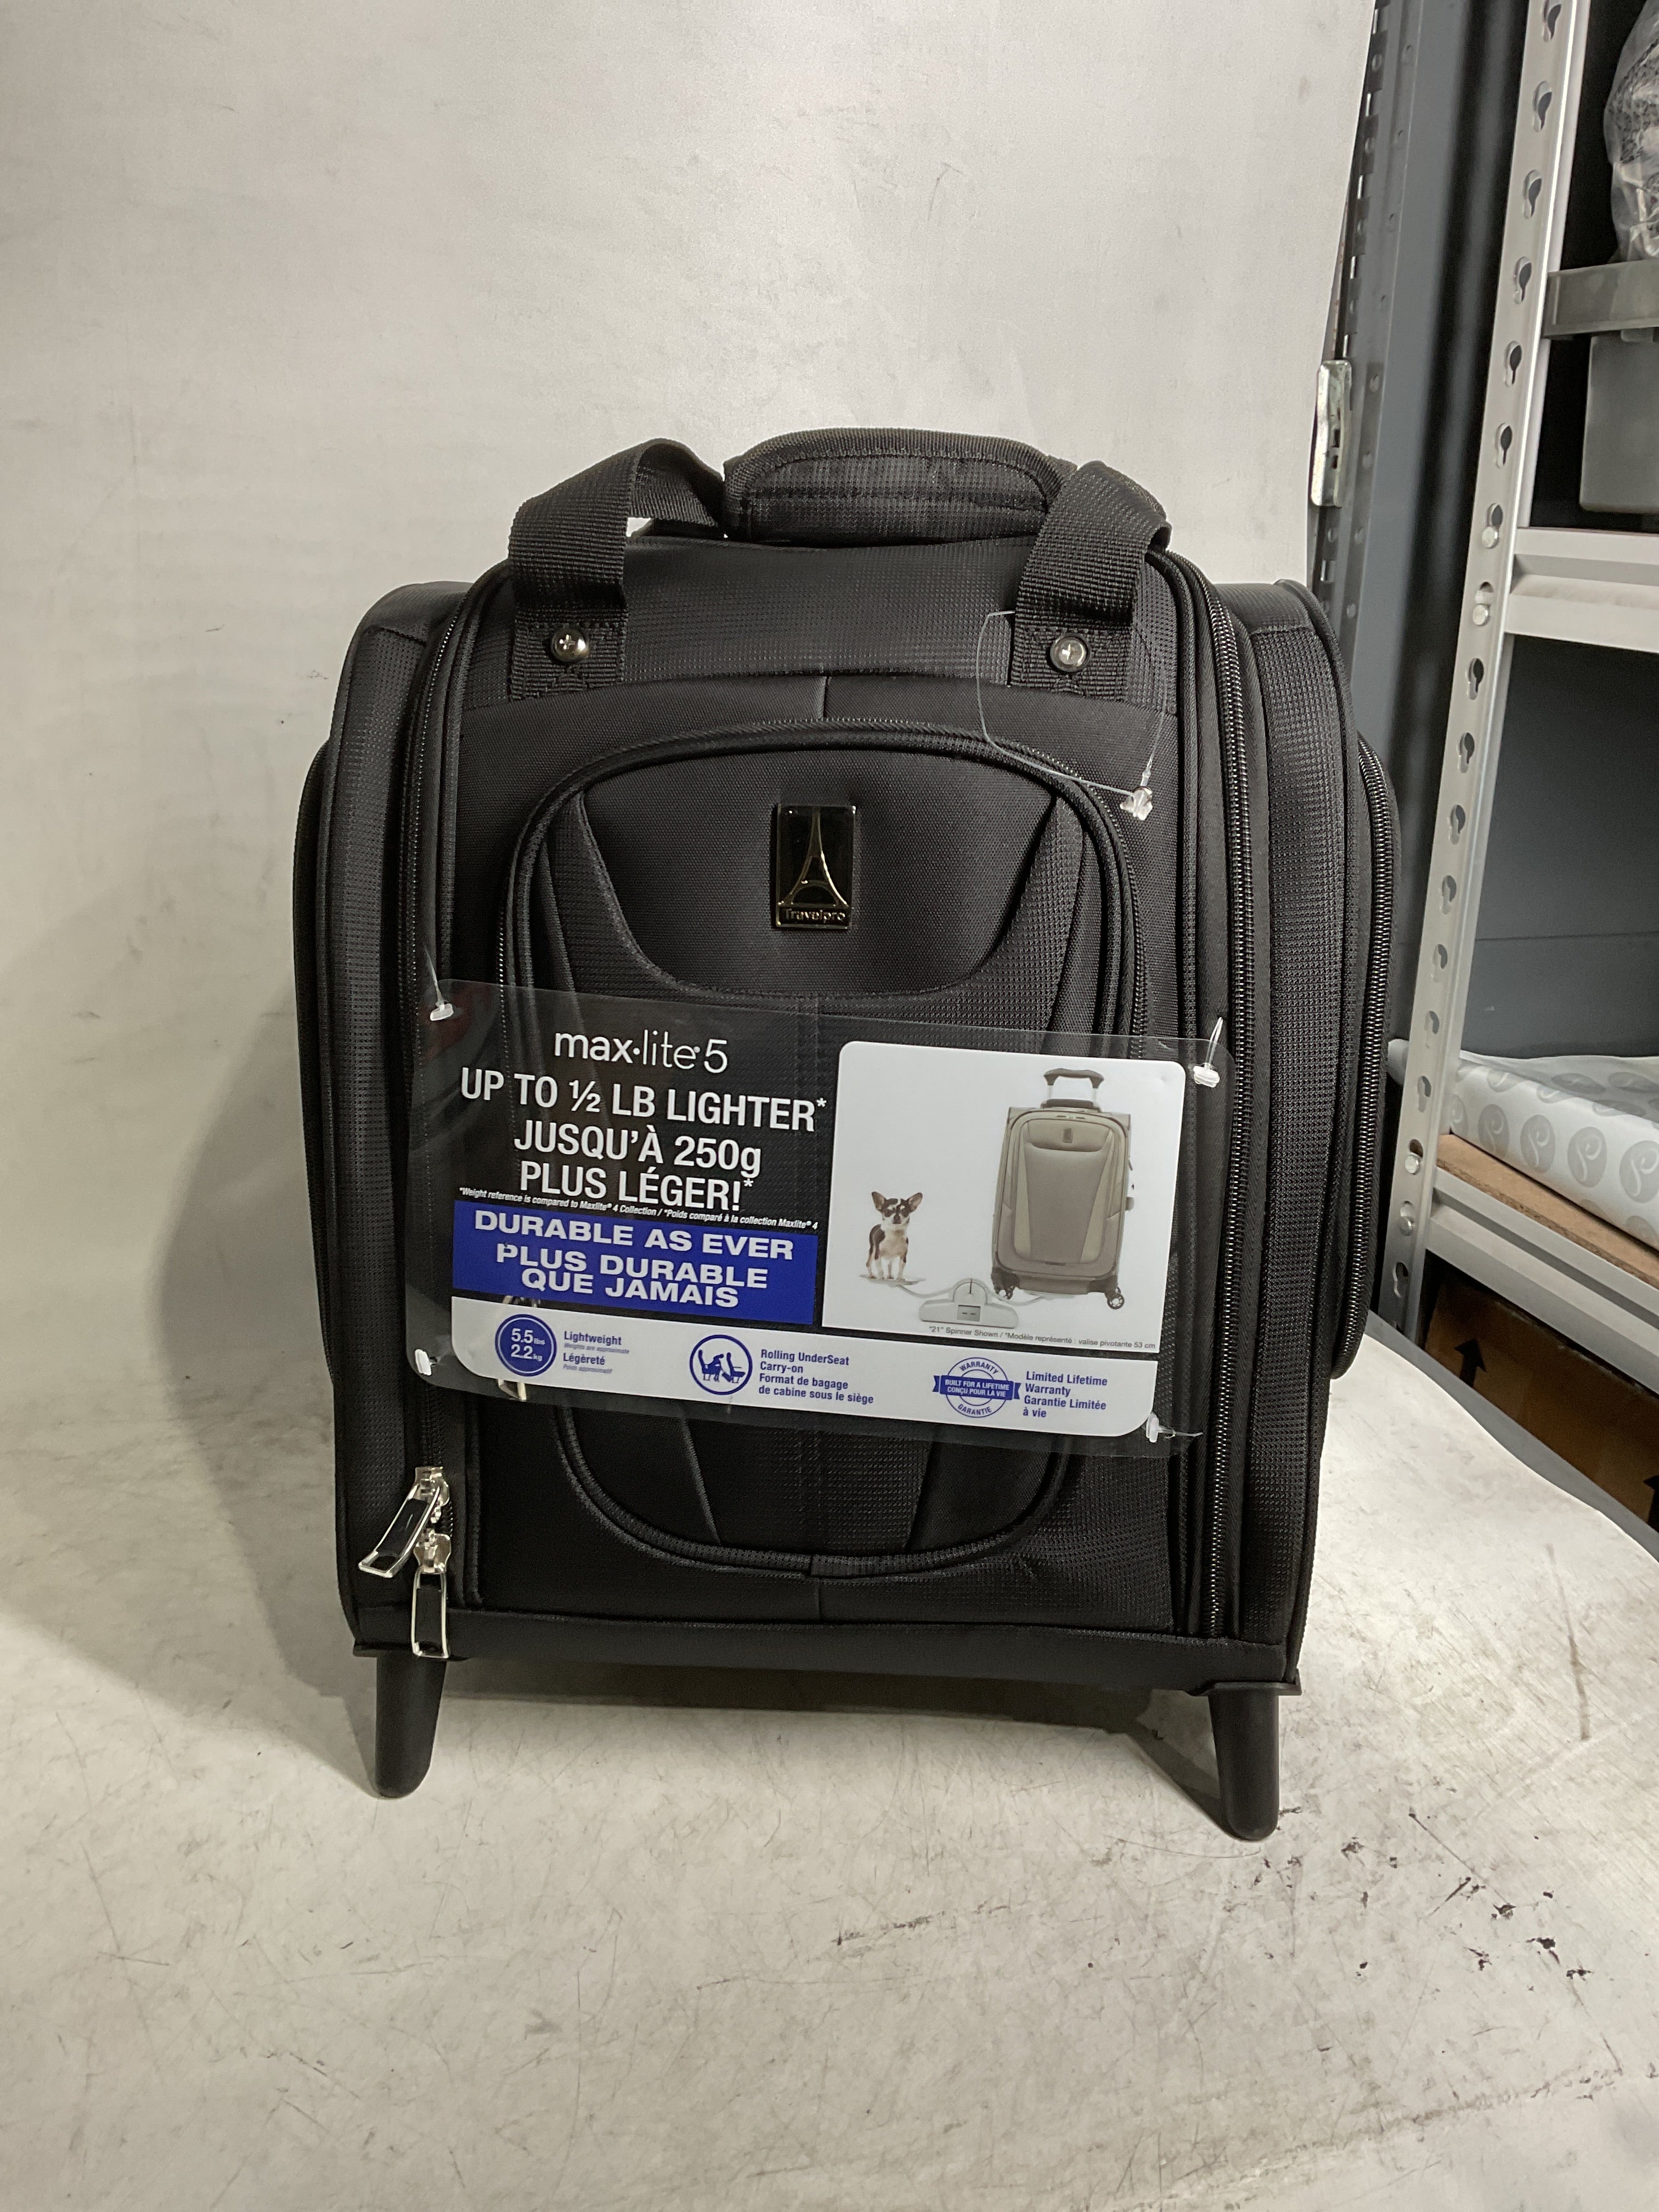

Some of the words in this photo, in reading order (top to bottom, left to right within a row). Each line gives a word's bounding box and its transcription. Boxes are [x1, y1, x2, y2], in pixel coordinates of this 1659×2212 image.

[785, 908, 846, 924] Travelpro
[461, 1067, 504, 1101] UP
[514, 1073, 558, 1108] TO
[612, 1084, 656, 1118] LB
[674, 1136, 761, 1178] 250g
[521, 1160, 607, 1199] PLUS
[488, 1191, 523, 1202] reference
[524, 1194, 531, 1203] is
[532, 1197, 569, 1207] compared
[571, 1200, 579, 1208] to
[619, 1206, 657, 1216] Collection
[689, 1212, 723, 1223] comparé
[724, 1214, 730, 1222] à
[730, 1215, 738, 1223] la
[740, 1216, 777, 1227] collection
[475, 1210, 634, 1246] DURABLE
[644, 1229, 692, 1252] AS
[702, 1234, 794, 1261] EVER
[496, 1243, 588, 1272] PLUS
[600, 1255, 769, 1289] DURABLE
[521, 1268, 595, 1294] QUE
[605, 1278, 740, 1308] JAMAIS
[564, 1330, 622, 1346] Lightweight
[946, 1327, 972, 1335] Spinner
[974, 1329, 998, 1338] Shown
[1035, 1335, 1073, 1344] représenté
[1100, 1340, 1132, 1348] pivotante
[563, 1352, 605, 1365] Légèreté
[761, 1349, 795, 1362] Rolling
[798, 1352, 850, 1365] UnderSeat
[760, 1361, 804, 1374] Carry-on
[960, 1361, 999, 1374] WARRANTY
[759, 1373, 794, 1385] Format
[797, 1376, 809, 1386] de
[812, 1378, 849, 1391] bagage
[982, 1382, 1010, 1391] LIFETIME
[1026, 1371, 1064, 1383] Limited
[1067, 1374, 1108, 1386] Lifetime
[759, 1385, 771, 1395] de
[774, 1387, 806, 1398] cabine
[809, 1391, 833, 1400] sous
[836, 1391, 844, 1401] le
[848, 1392, 874, 1404] siège
[947, 1386, 968, 1395] CONÇU
[1025, 1383, 1071, 1397] Warranty
[957, 1403, 992, 1415] GARANTIE
[1024, 1395, 1066, 1408] Garantie
[1069, 1398, 1107, 1410] Limitée
[1023, 1407, 1029, 1417] à
[1032, 1408, 1047, 1418] vie
